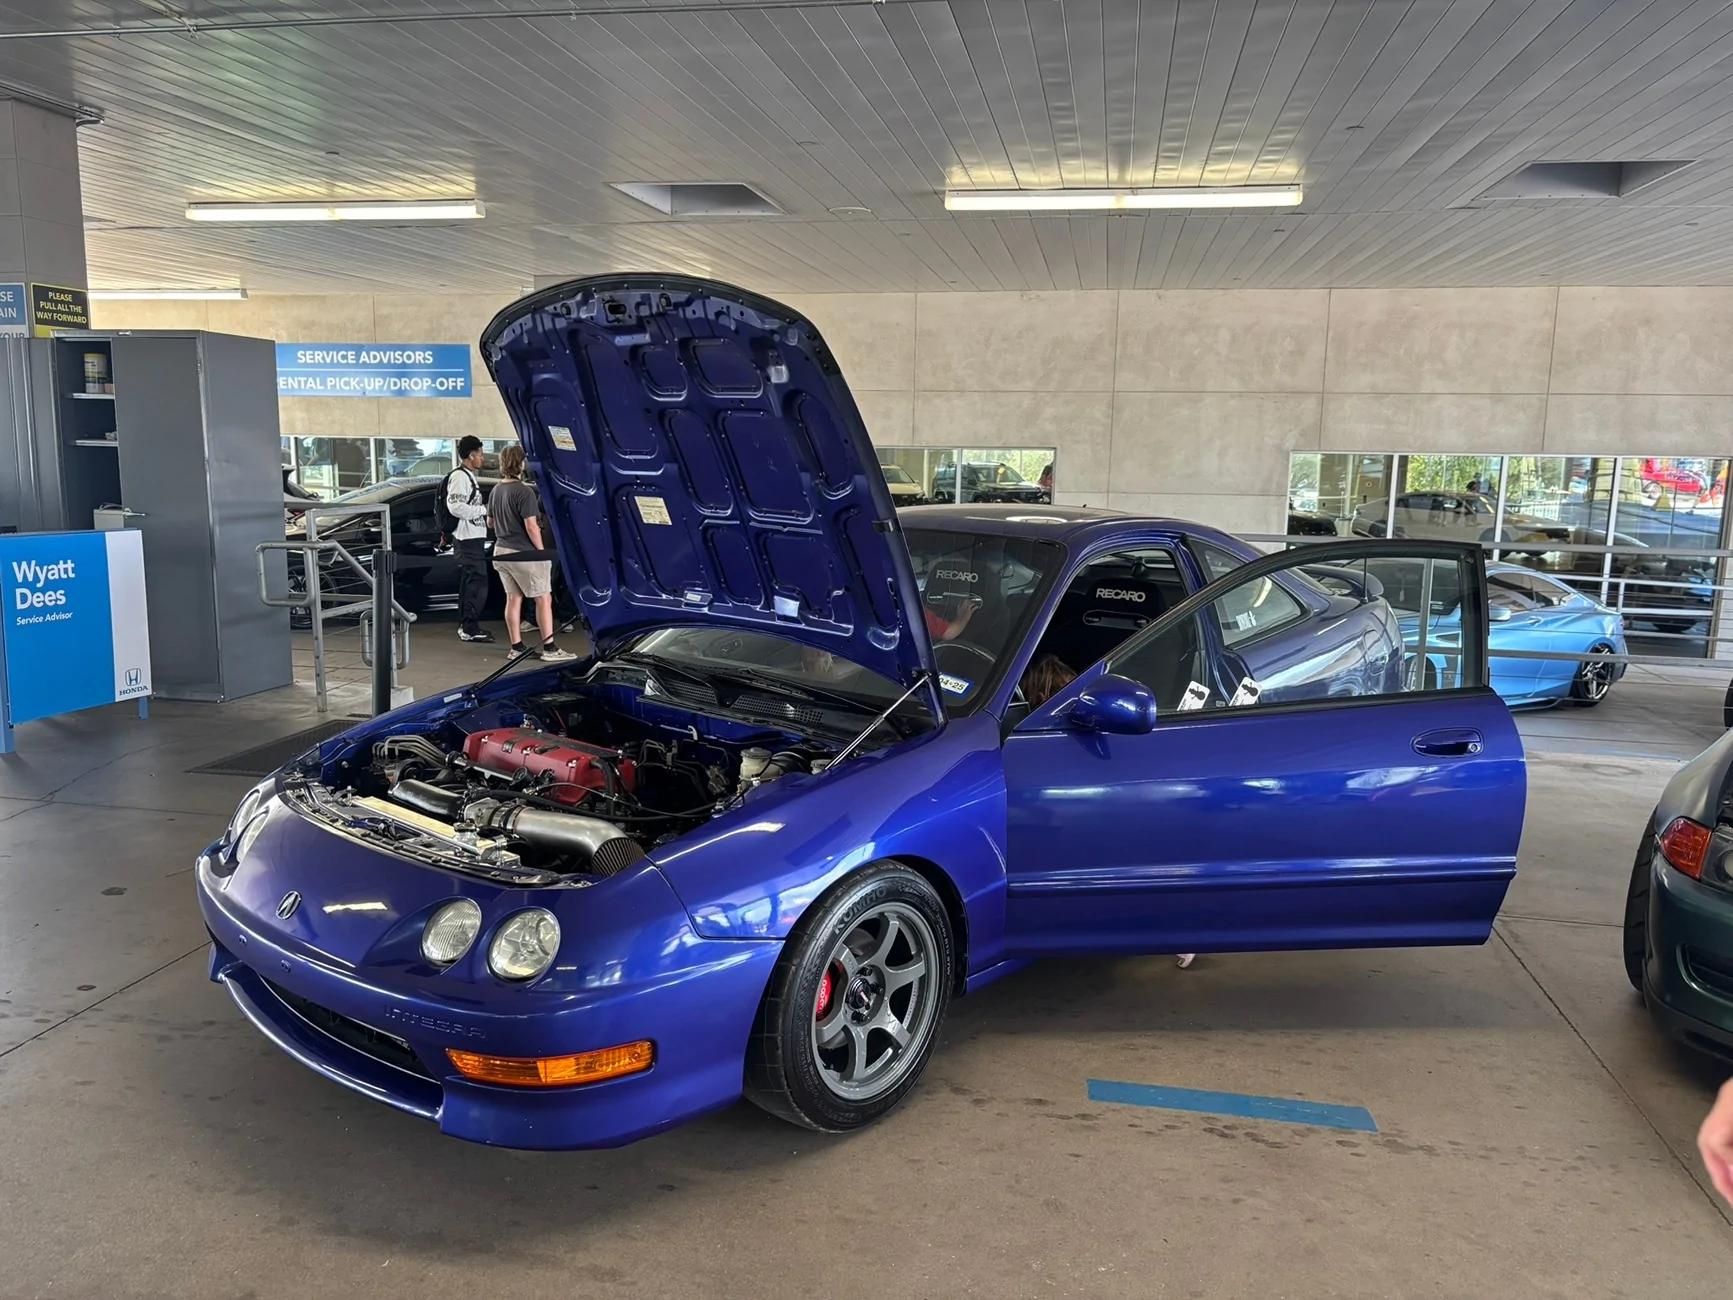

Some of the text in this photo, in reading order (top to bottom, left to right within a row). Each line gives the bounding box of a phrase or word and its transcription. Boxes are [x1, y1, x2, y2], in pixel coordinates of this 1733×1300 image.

[48, 291, 73, 302] PLEASE
[39, 301, 82, 314] PULL ALL THE
[36, 311, 87, 324] WAY FORWARD
[297, 350, 434, 364] SERVICE ADVISORS
[277, 376, 465, 392] ENTAL PICK-UP/DROP-OFF
[12, 559, 76, 588] Wyatt
[936, 569, 979, 583] RECARO
[15, 587, 67, 610] Dees
[1095, 587, 1146, 603] RECARO
[16, 611, 73, 626] Service Advisor
[119, 685, 149, 696] HONDA
[833, 885, 888, 935] KUMHO
